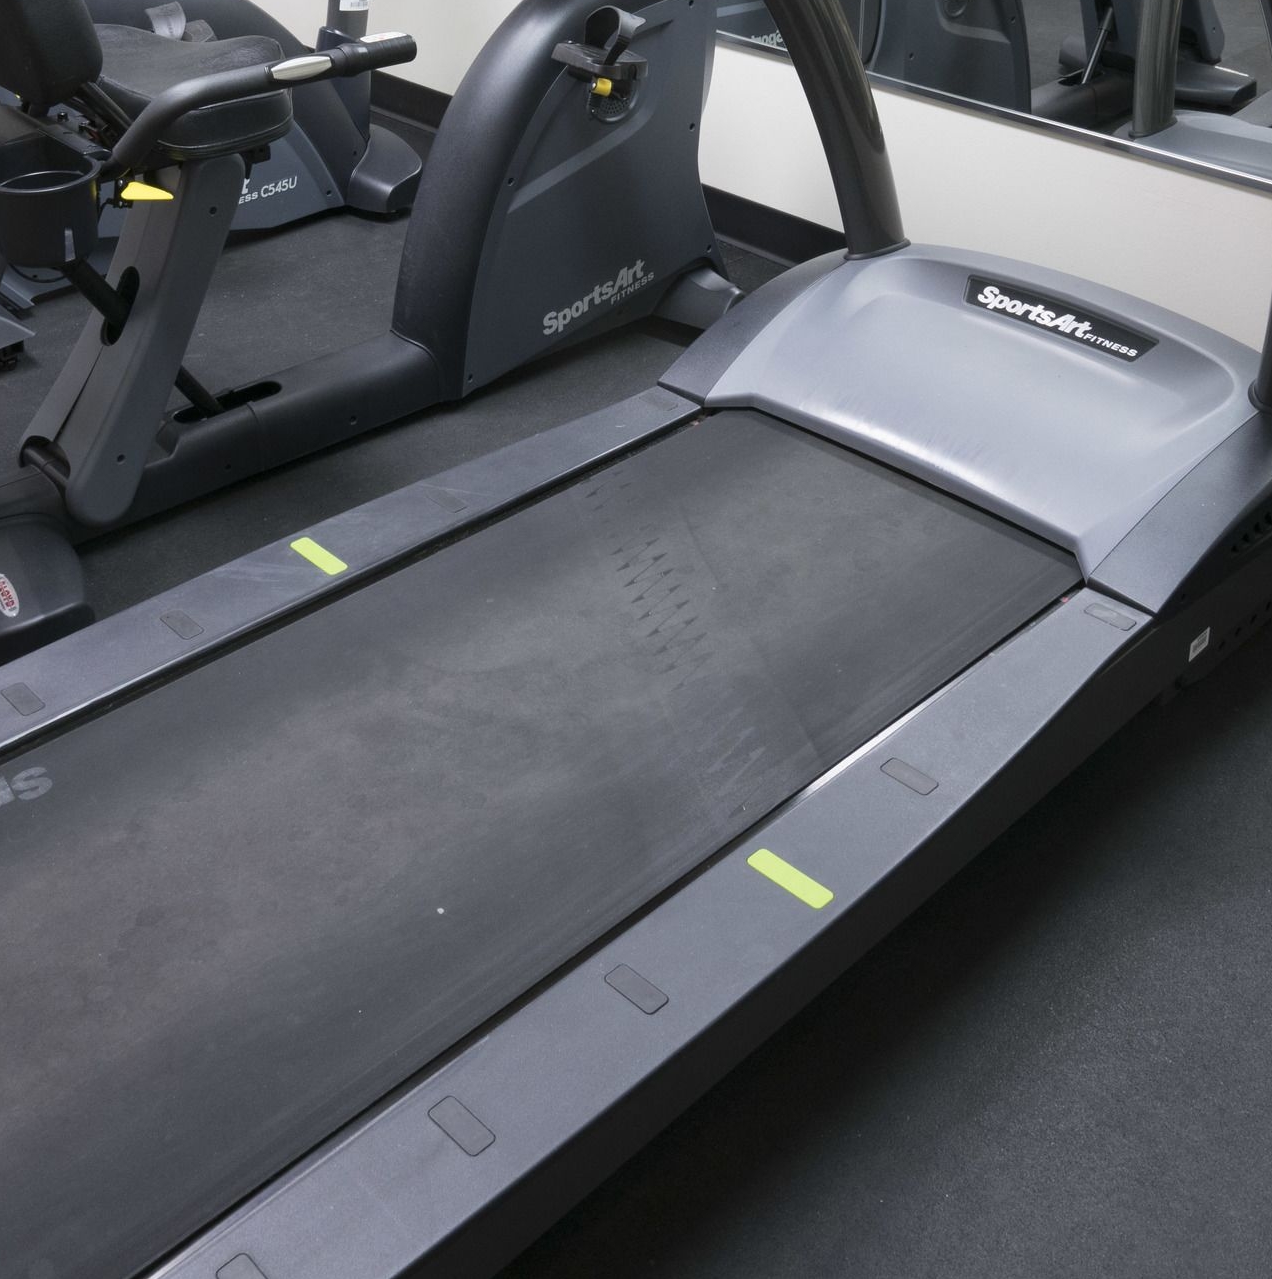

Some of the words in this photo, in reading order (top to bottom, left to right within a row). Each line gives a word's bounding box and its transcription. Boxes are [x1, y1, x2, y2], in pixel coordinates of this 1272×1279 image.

[261, 176, 298, 198] C545U
[543, 259, 645, 335] SportsArt
[611, 272, 655, 305] FITNESS
[977, 285, 1092, 338] SportsArt
[1083, 333, 1138, 357] FITNESS
